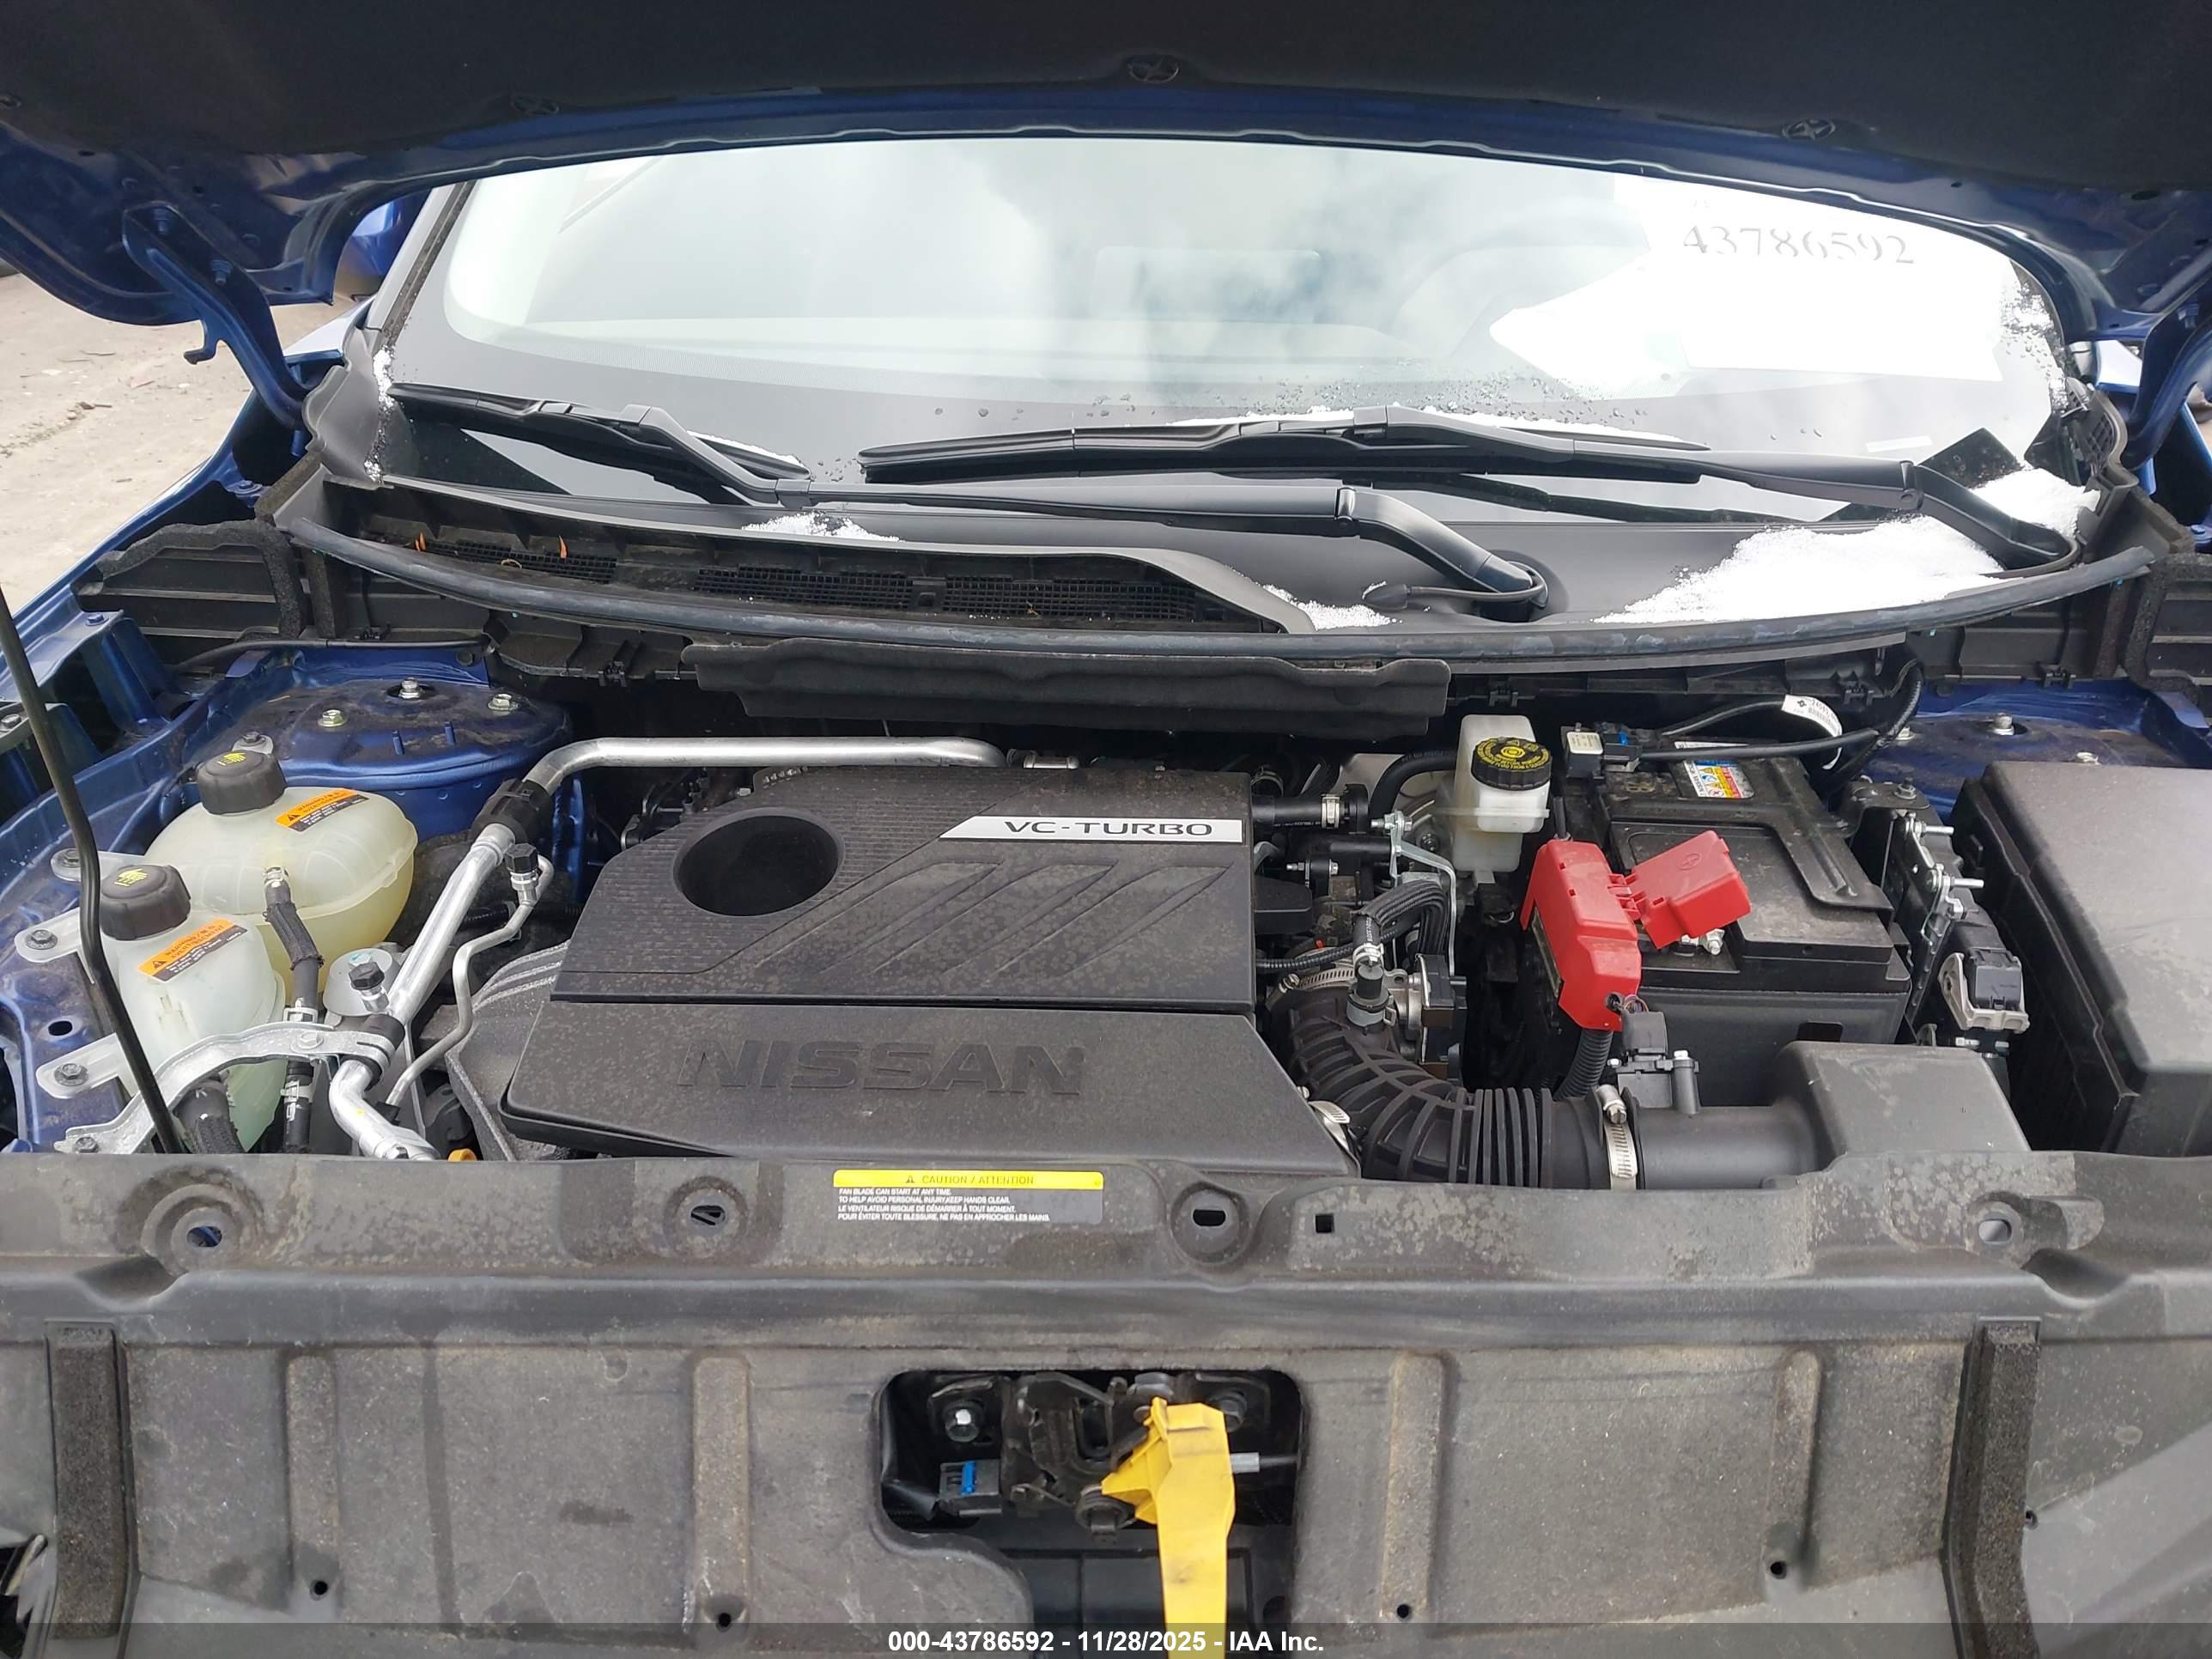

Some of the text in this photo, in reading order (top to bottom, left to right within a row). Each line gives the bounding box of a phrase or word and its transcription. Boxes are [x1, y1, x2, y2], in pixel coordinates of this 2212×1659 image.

[1683, 225, 1914, 264] 43786592
[1004, 821, 1212, 836] VC-TURBO
[677, 1040, 1086, 1096] NISSAN
[922, 1176, 968, 1184] CAUTION
[978, 1176, 1035, 1185] ATTENTION
[927, 1203, 963, 1212] DÉMARRER
[859, 1211, 881, 1220] ÉVITER
